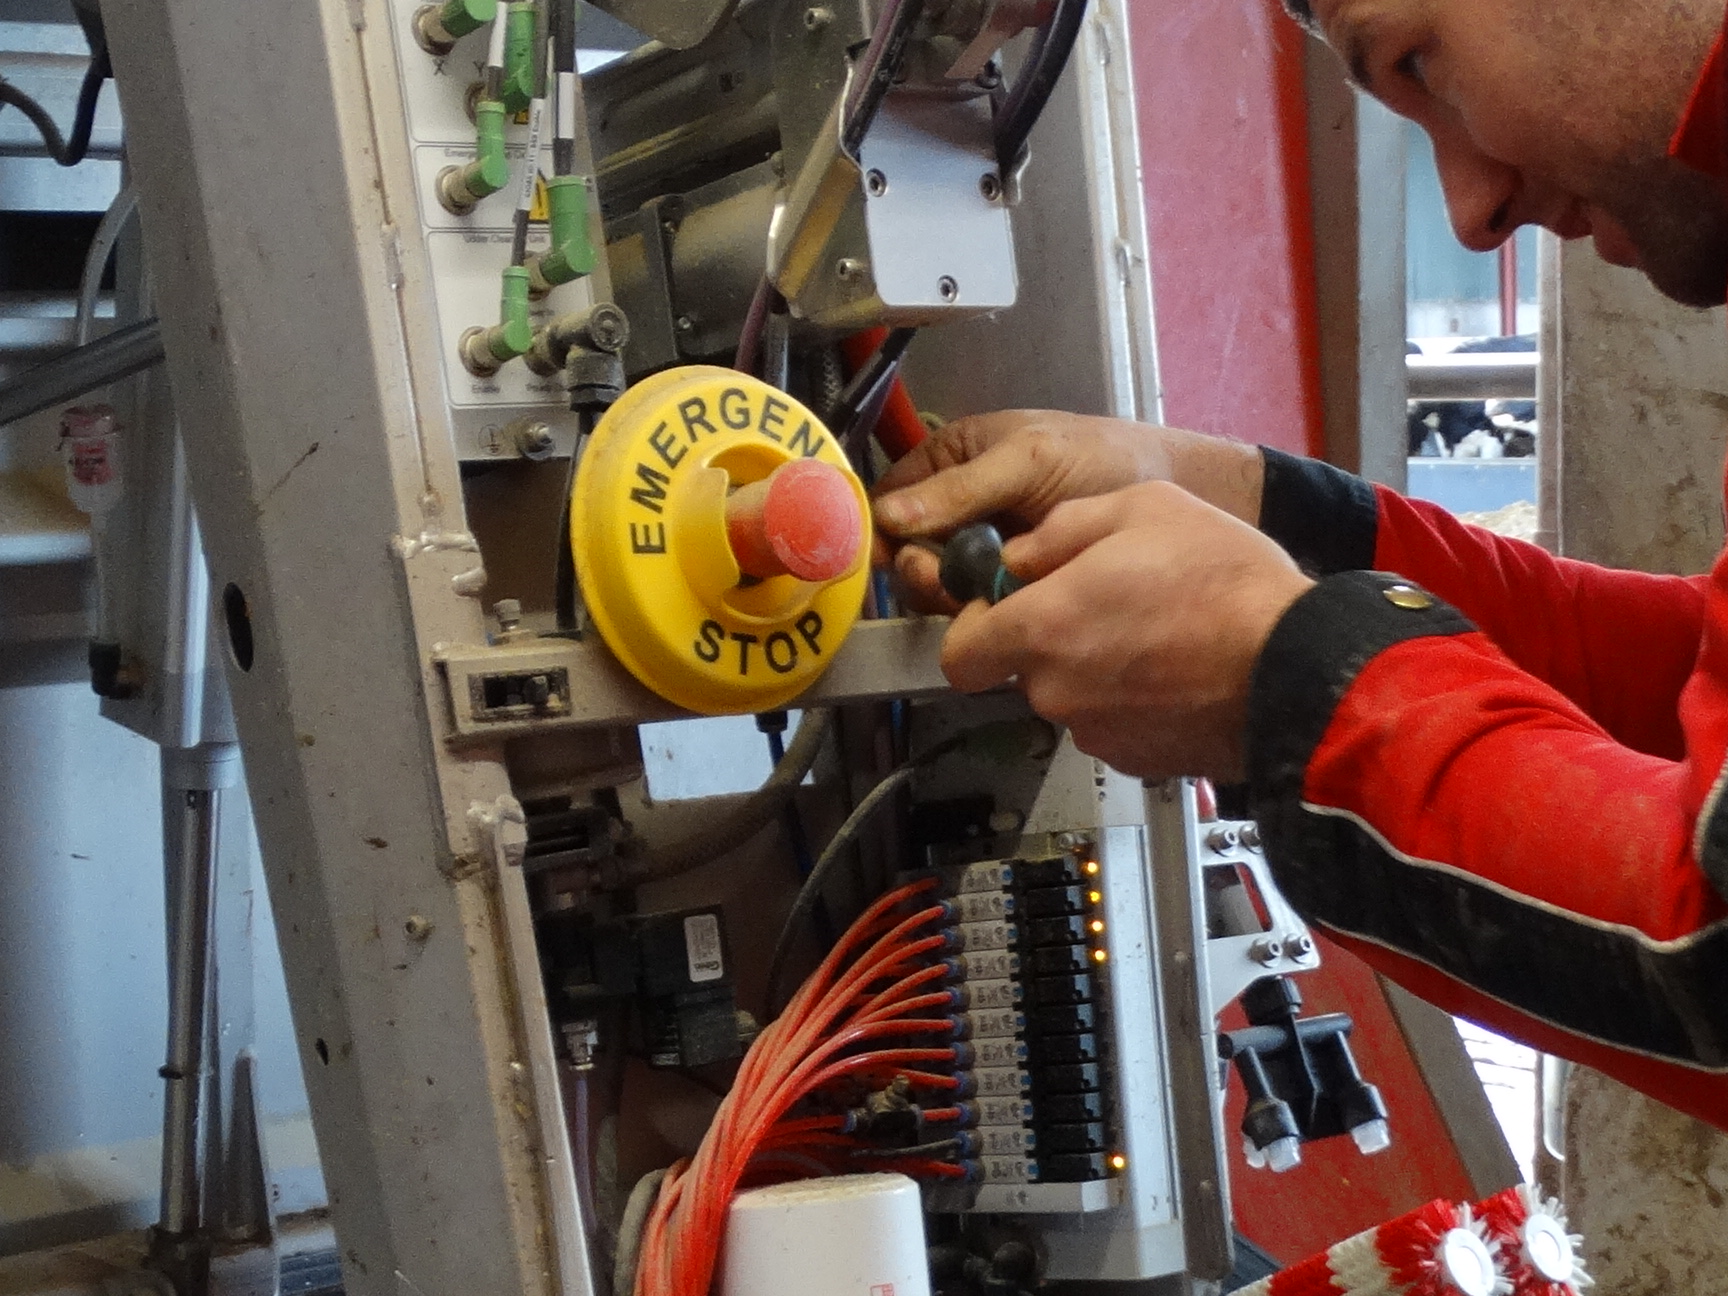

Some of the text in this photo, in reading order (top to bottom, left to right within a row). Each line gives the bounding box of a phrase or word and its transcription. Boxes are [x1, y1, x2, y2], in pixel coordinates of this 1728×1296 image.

[432, 59, 446, 76] X
[472, 60, 487, 77] Y
[629, 388, 826, 555] EMERGEN
[694, 610, 823, 674] STOP
